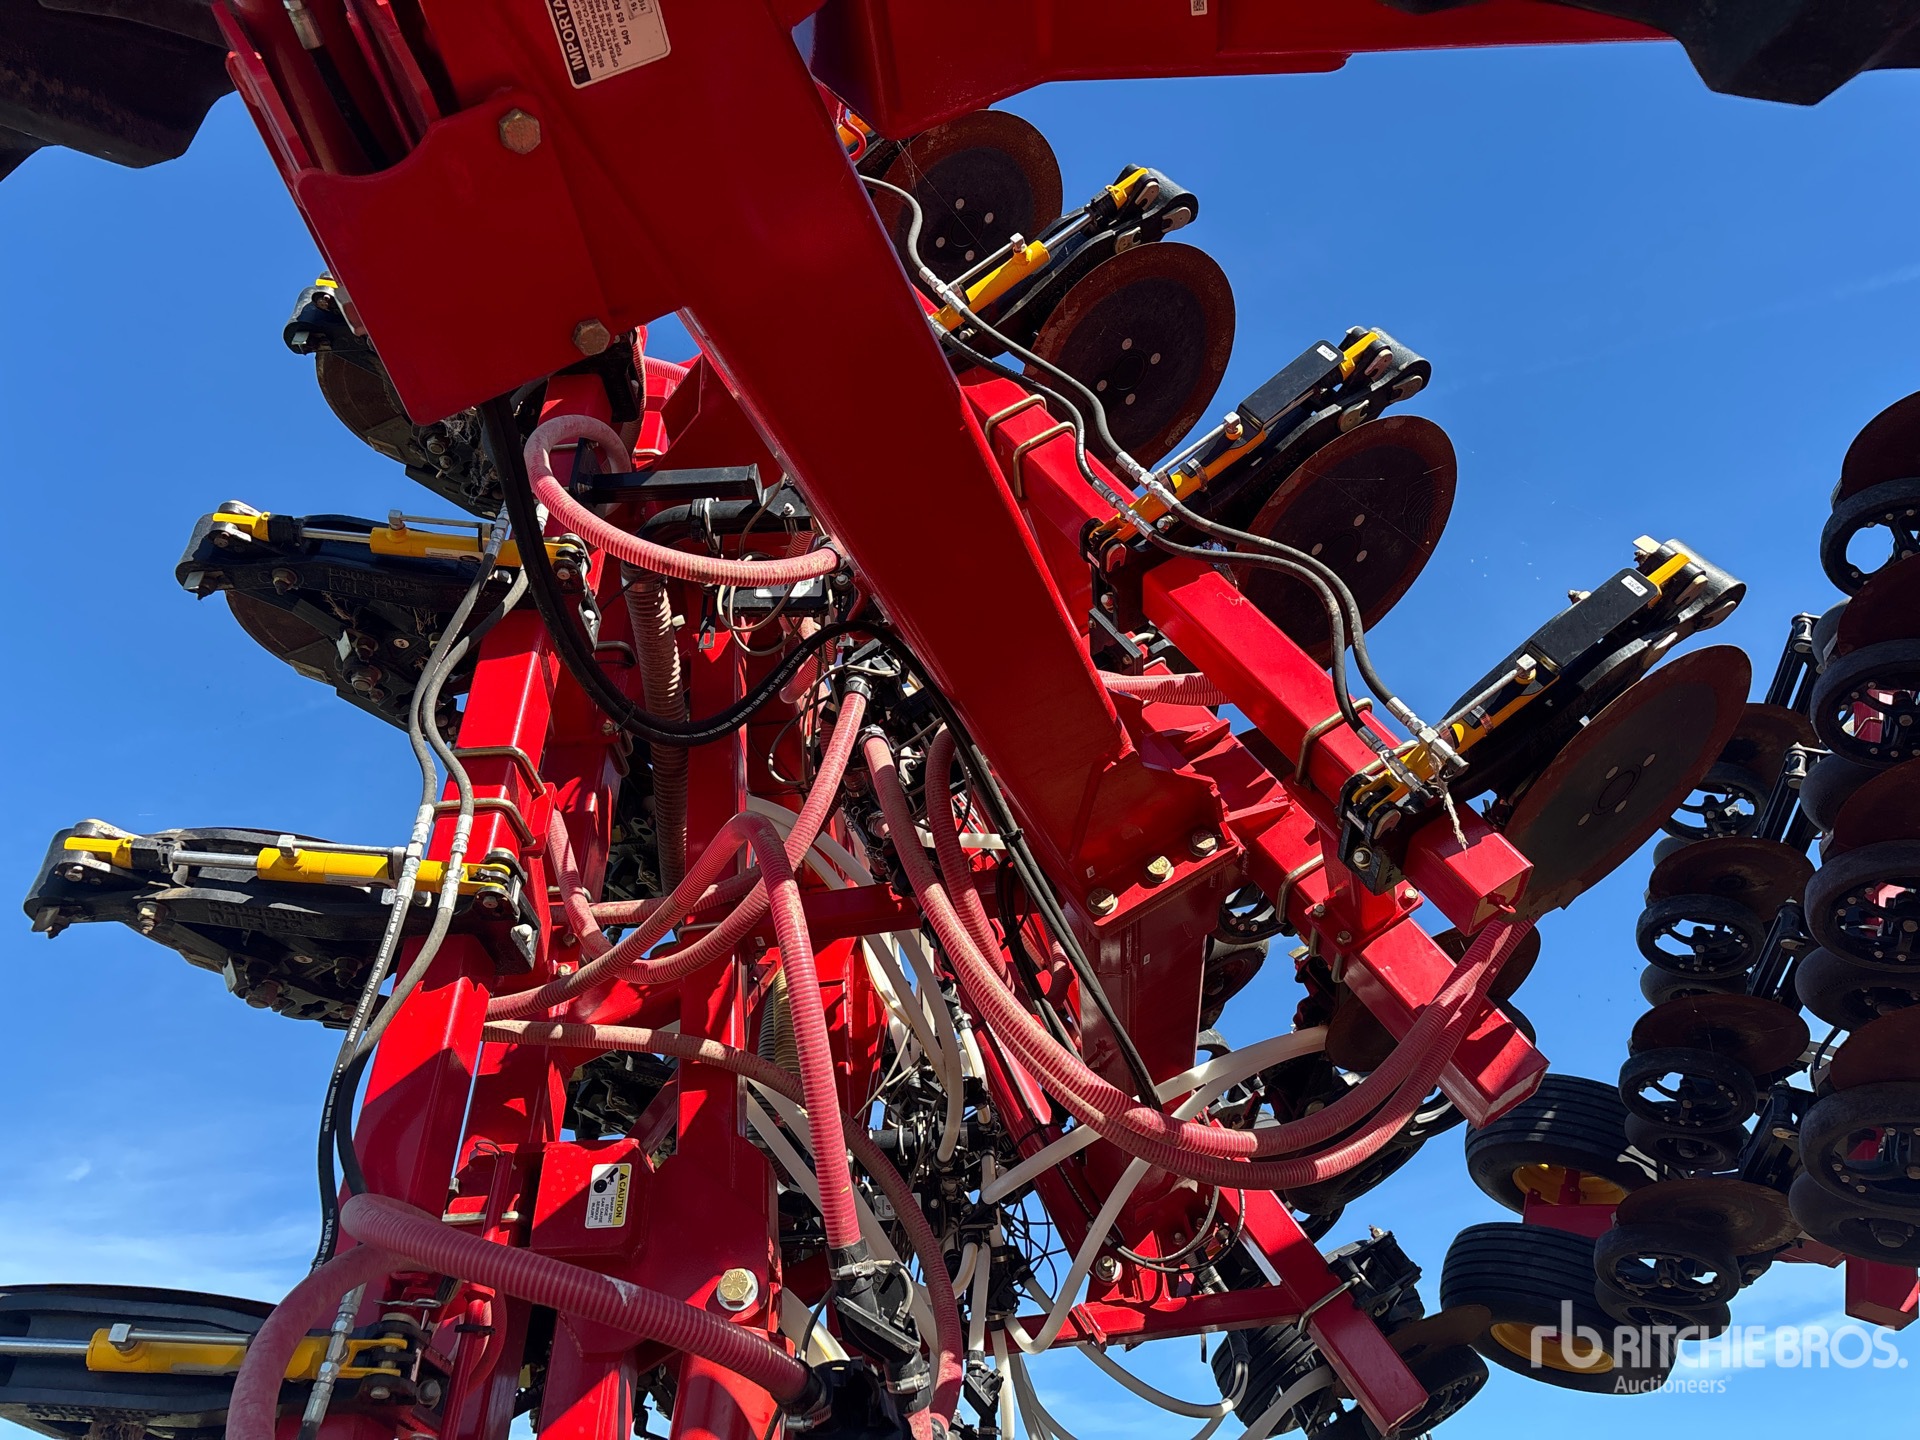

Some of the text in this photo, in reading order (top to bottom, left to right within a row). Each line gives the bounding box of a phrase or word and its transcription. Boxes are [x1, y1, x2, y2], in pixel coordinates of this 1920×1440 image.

[575, 10, 584, 25] THIS
[598, 13, 606, 27] THE
[605, 11, 614, 26] TIRE
[615, 11, 624, 23] 65
[580, 26, 588, 37] ON
[585, 17, 599, 49] FACTORY
[594, 23, 606, 51] PROPER
[602, 27, 609, 37] AT
[610, 27, 618, 41] THE
[620, 29, 631, 45] 540
[584, 37, 592, 52] TIRE
[605, 37, 619, 67] OPERATE
[614, 42, 622, 56] FOR
[588, 53, 597, 67] THE
[595, 49, 604, 67] BEEN
[615, 1181, 625, 1217] CAUTION
[320, 1219, 333, 1253] PULSAR
